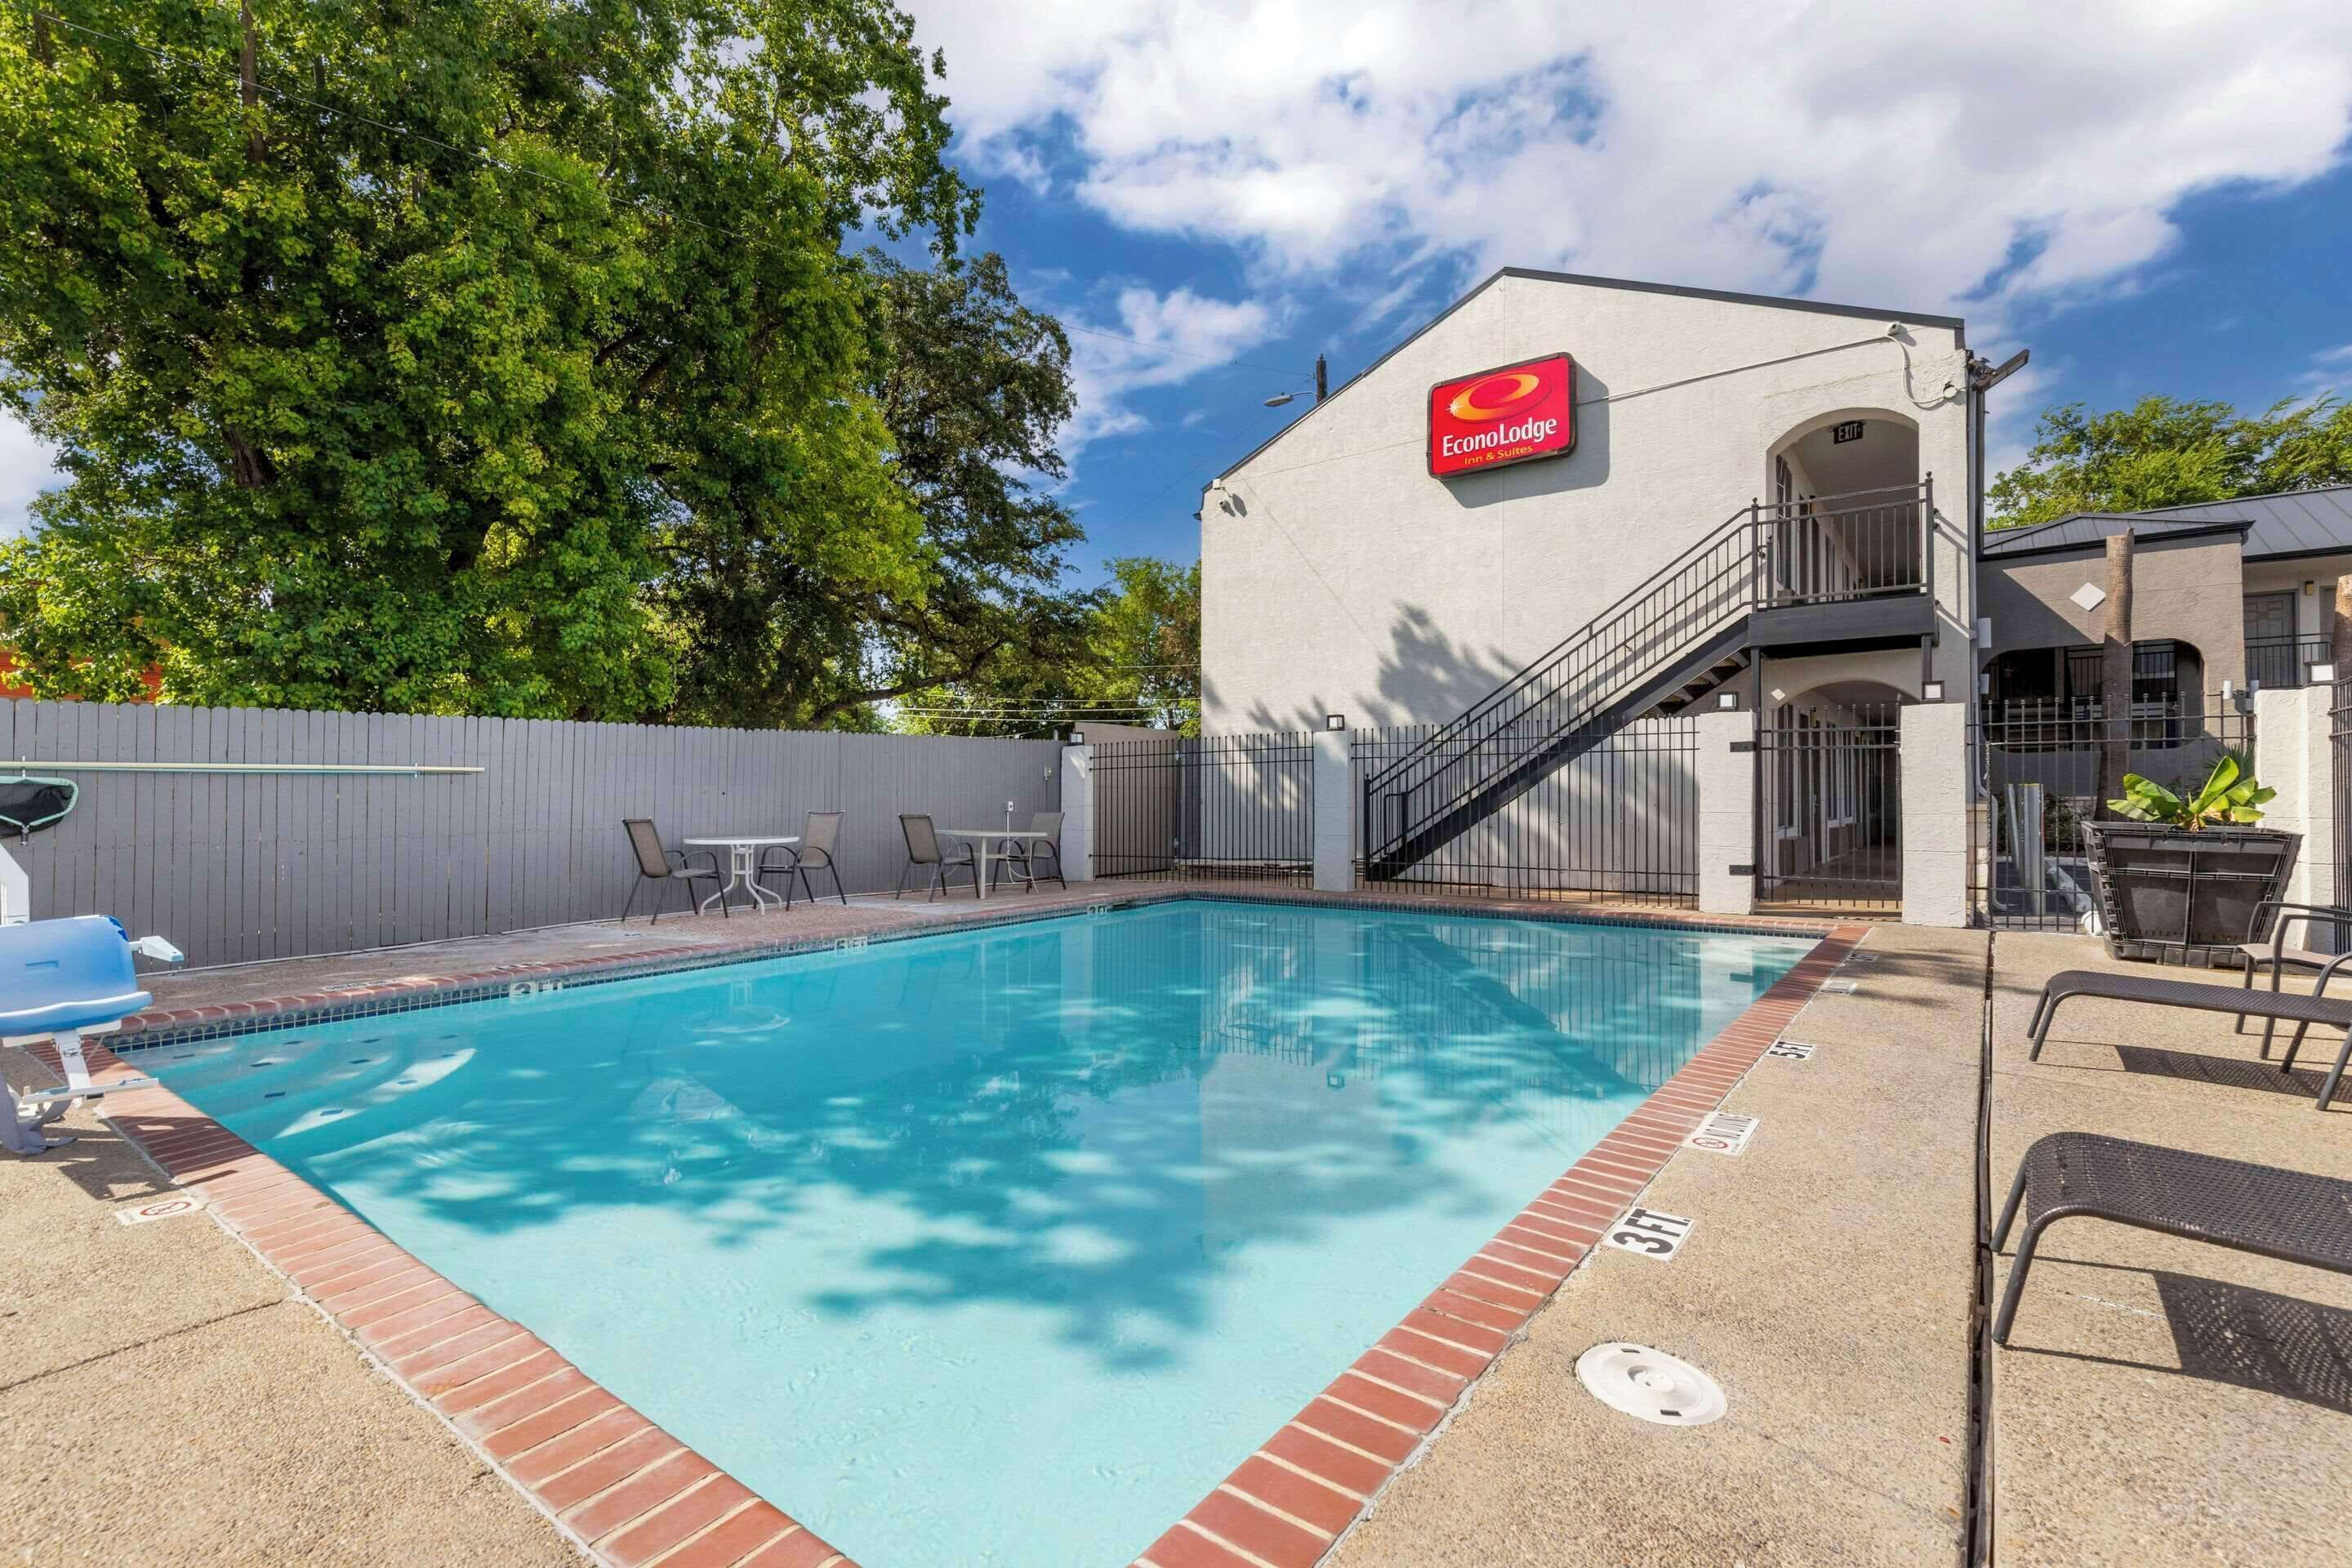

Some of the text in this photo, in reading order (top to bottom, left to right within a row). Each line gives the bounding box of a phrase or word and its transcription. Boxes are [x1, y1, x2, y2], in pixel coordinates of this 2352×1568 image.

[1442, 417, 1557, 457] EconoLodge
[1838, 423, 1860, 442] EXIT
[1464, 445, 1534, 466] Inn & Suites
